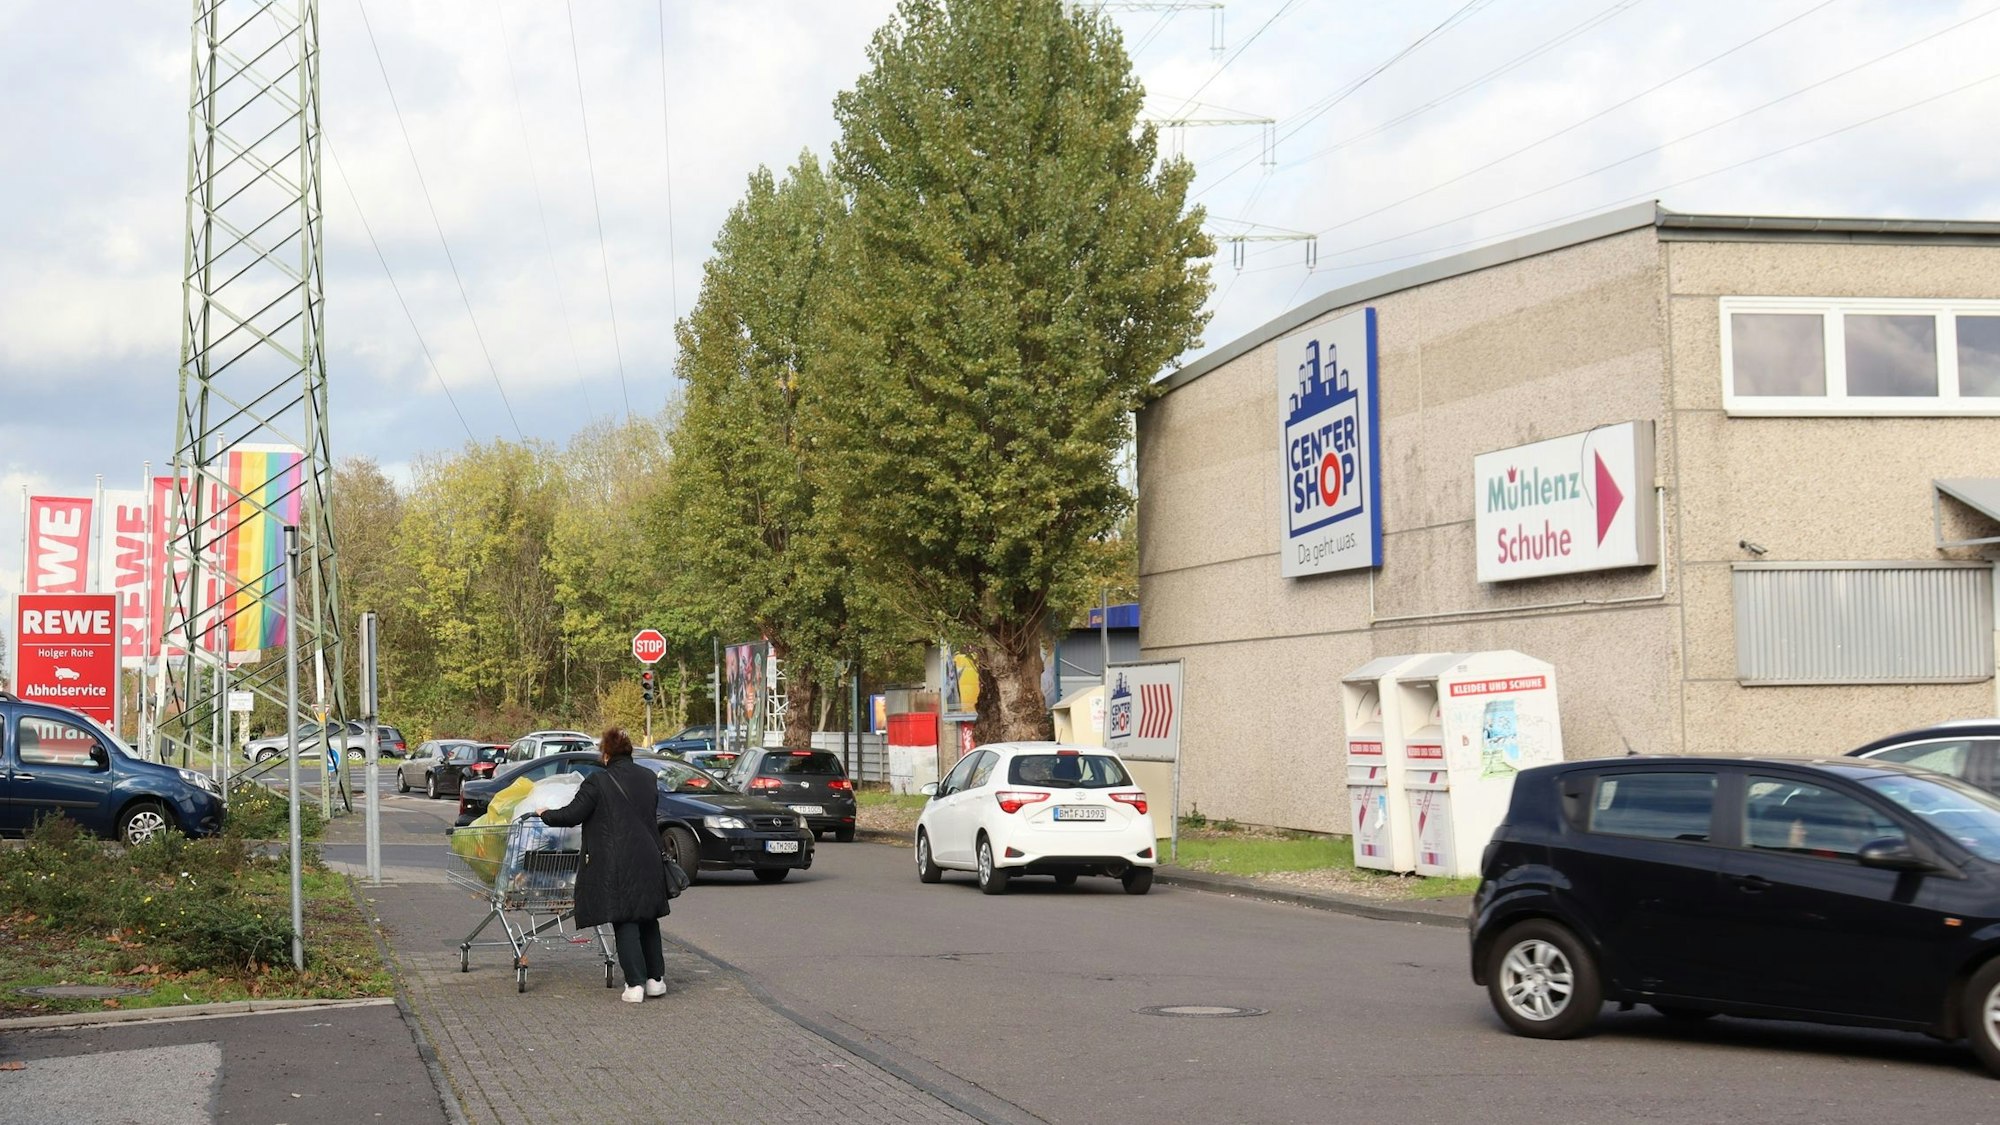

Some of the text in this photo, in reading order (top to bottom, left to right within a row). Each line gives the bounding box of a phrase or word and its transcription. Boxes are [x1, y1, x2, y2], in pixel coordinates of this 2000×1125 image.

[1291, 415, 1356, 472] CENTER
[1293, 452, 1355, 514] SHOP
[1298, 544, 1311, 565] Da
[1313, 536, 1334, 567] geht
[1497, 519, 1572, 564] Schuhe
[22, 610, 111, 635] REWE
[38, 648, 94, 659] Holger Rohe
[636, 640, 663, 653] STOP
[25, 684, 106, 696] Abholservice
[1454, 678, 1542, 695] KLEIDER UND SCHUHE
